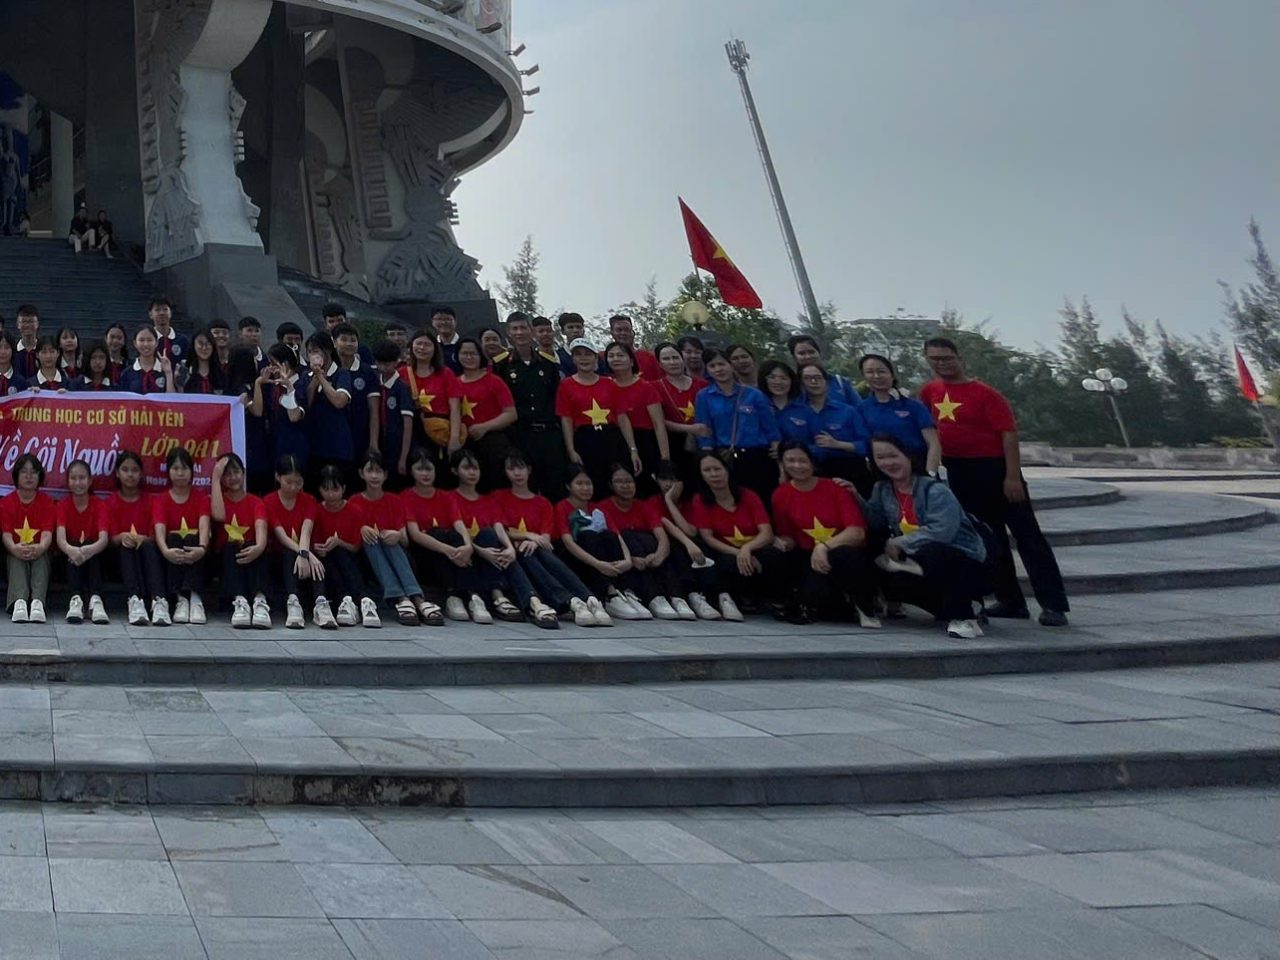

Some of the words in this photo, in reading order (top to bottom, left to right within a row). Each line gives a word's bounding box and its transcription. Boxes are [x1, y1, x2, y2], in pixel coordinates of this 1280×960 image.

[11, 406, 51, 423] TRUNG
[55, 408, 82, 427] HỌC
[86, 408, 105, 425] CƠ
[108, 405, 127, 426] SỞ
[60, 433, 125, 476] Nuồ
